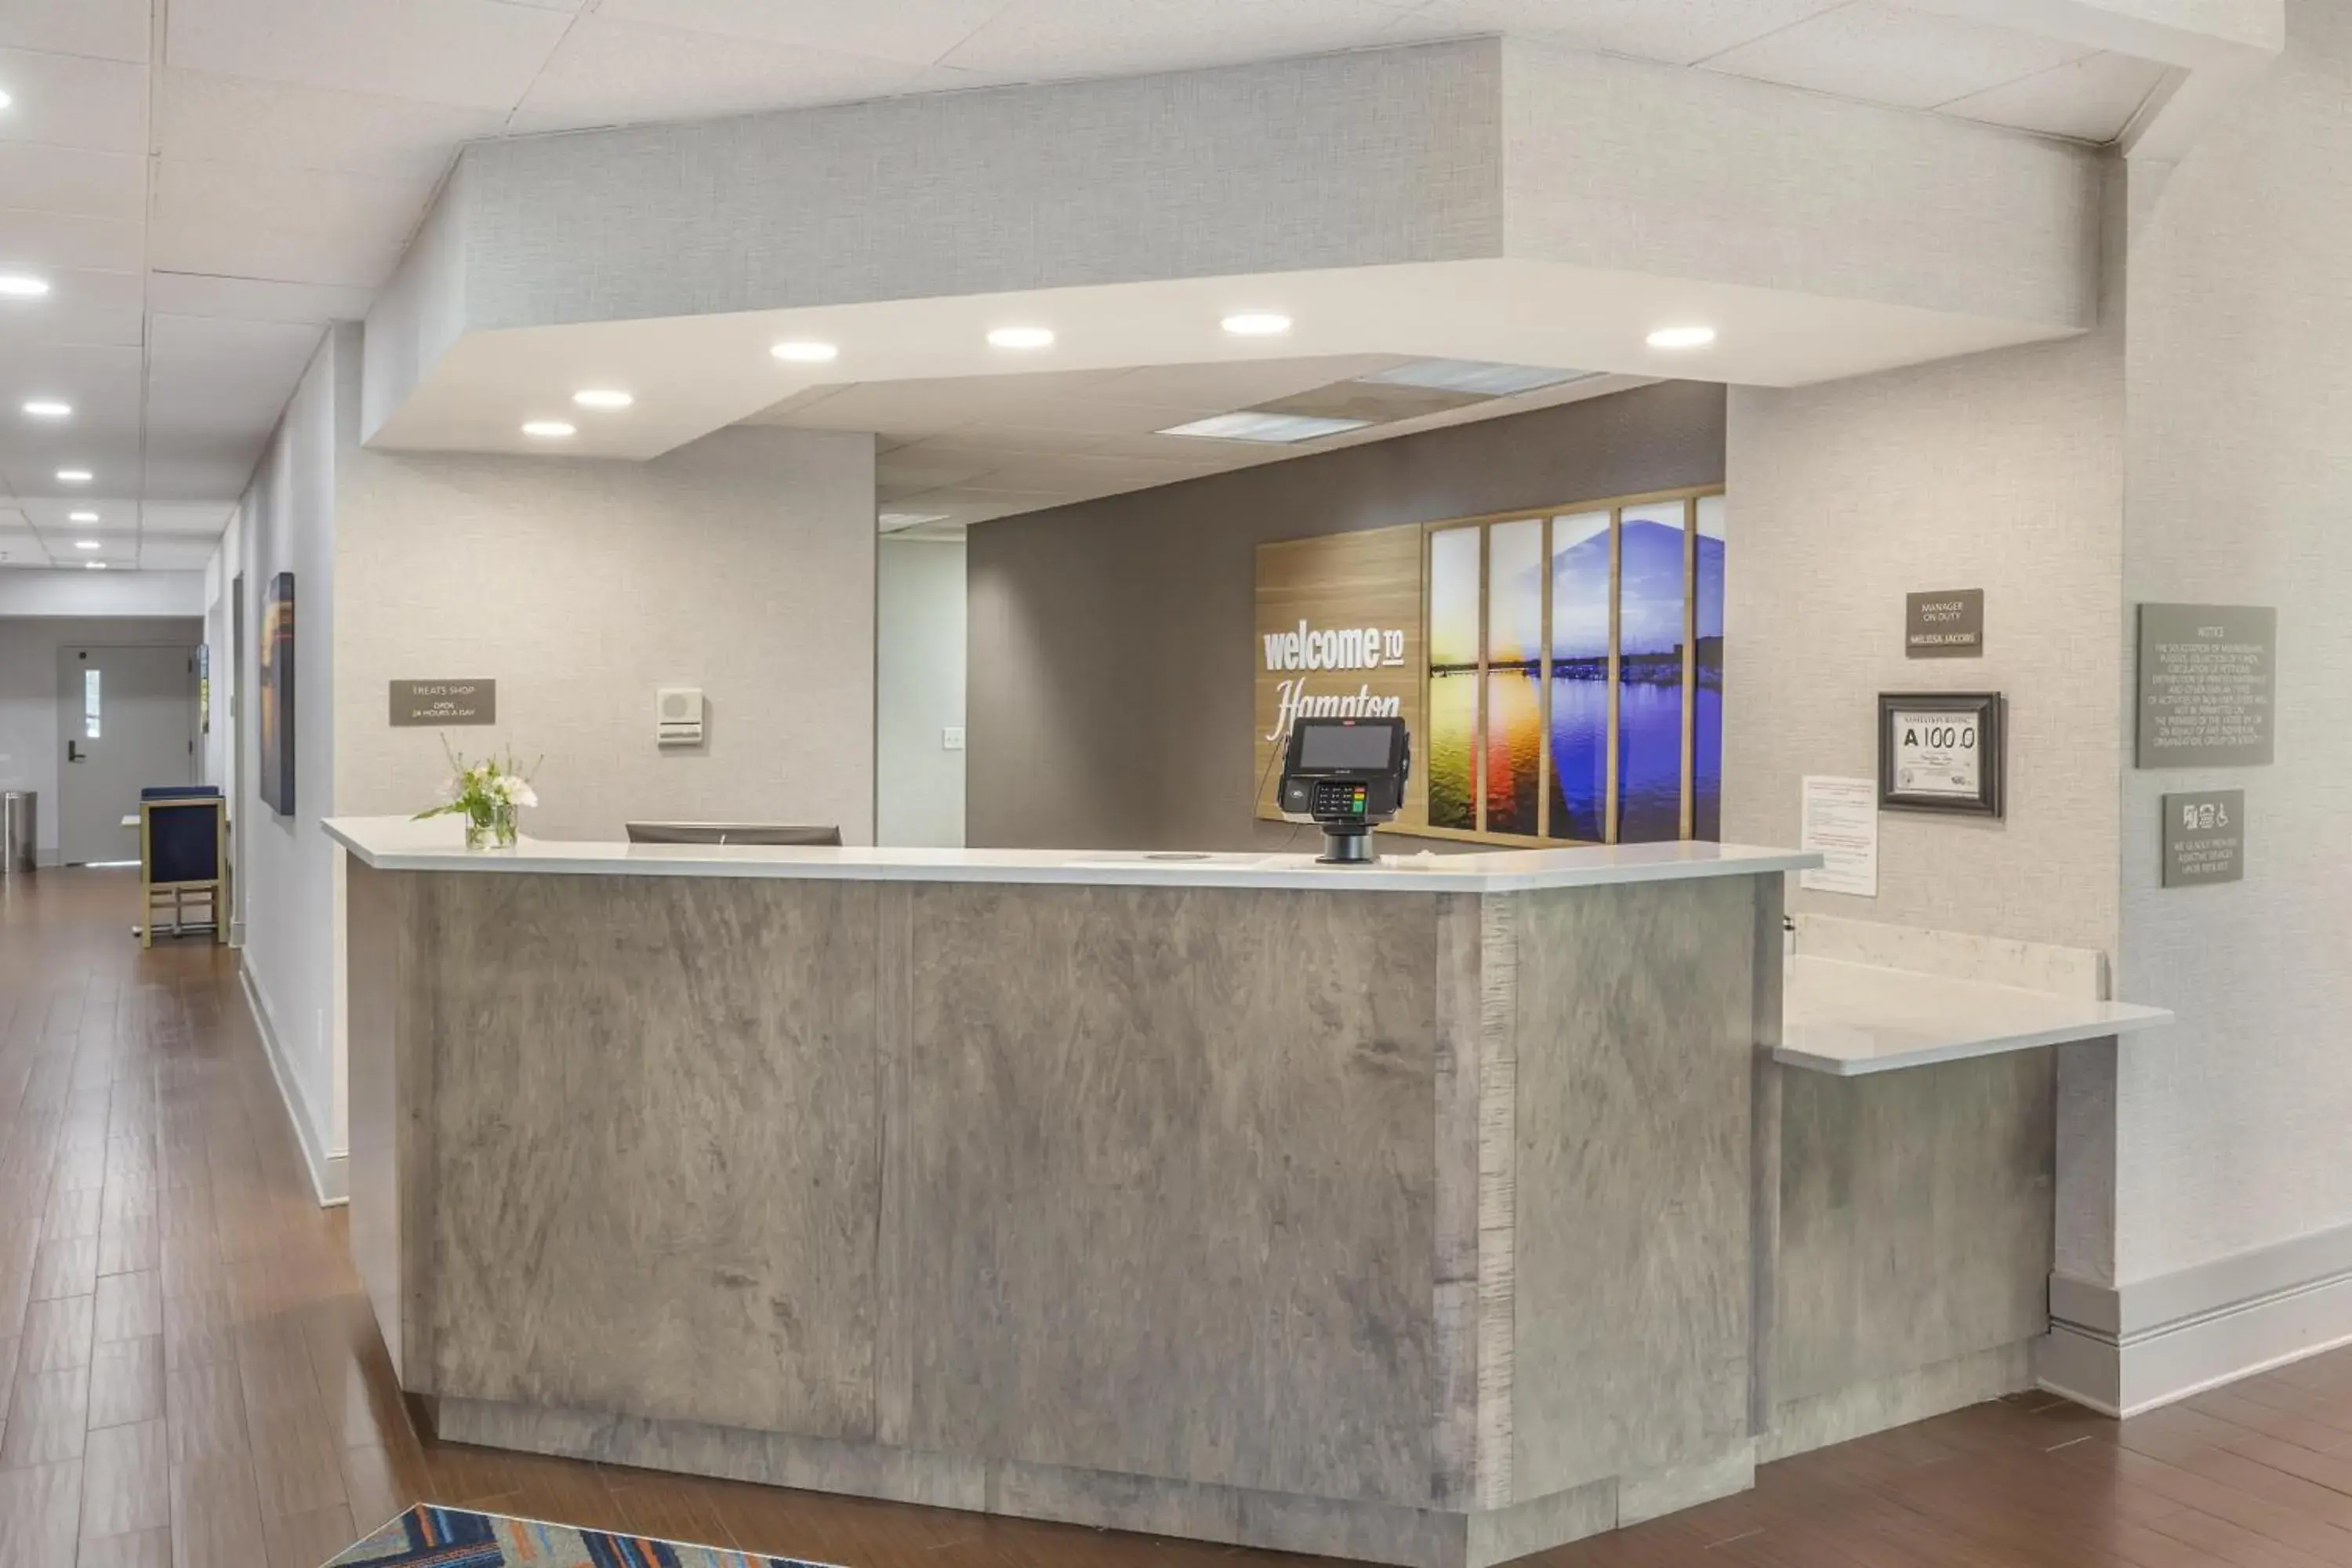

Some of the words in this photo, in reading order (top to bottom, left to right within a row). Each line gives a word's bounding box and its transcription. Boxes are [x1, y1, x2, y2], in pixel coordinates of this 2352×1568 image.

[1922, 612, 1936, 622] ON
[1263, 619, 1381, 670] welcome
[1904, 728, 1919, 746] A
